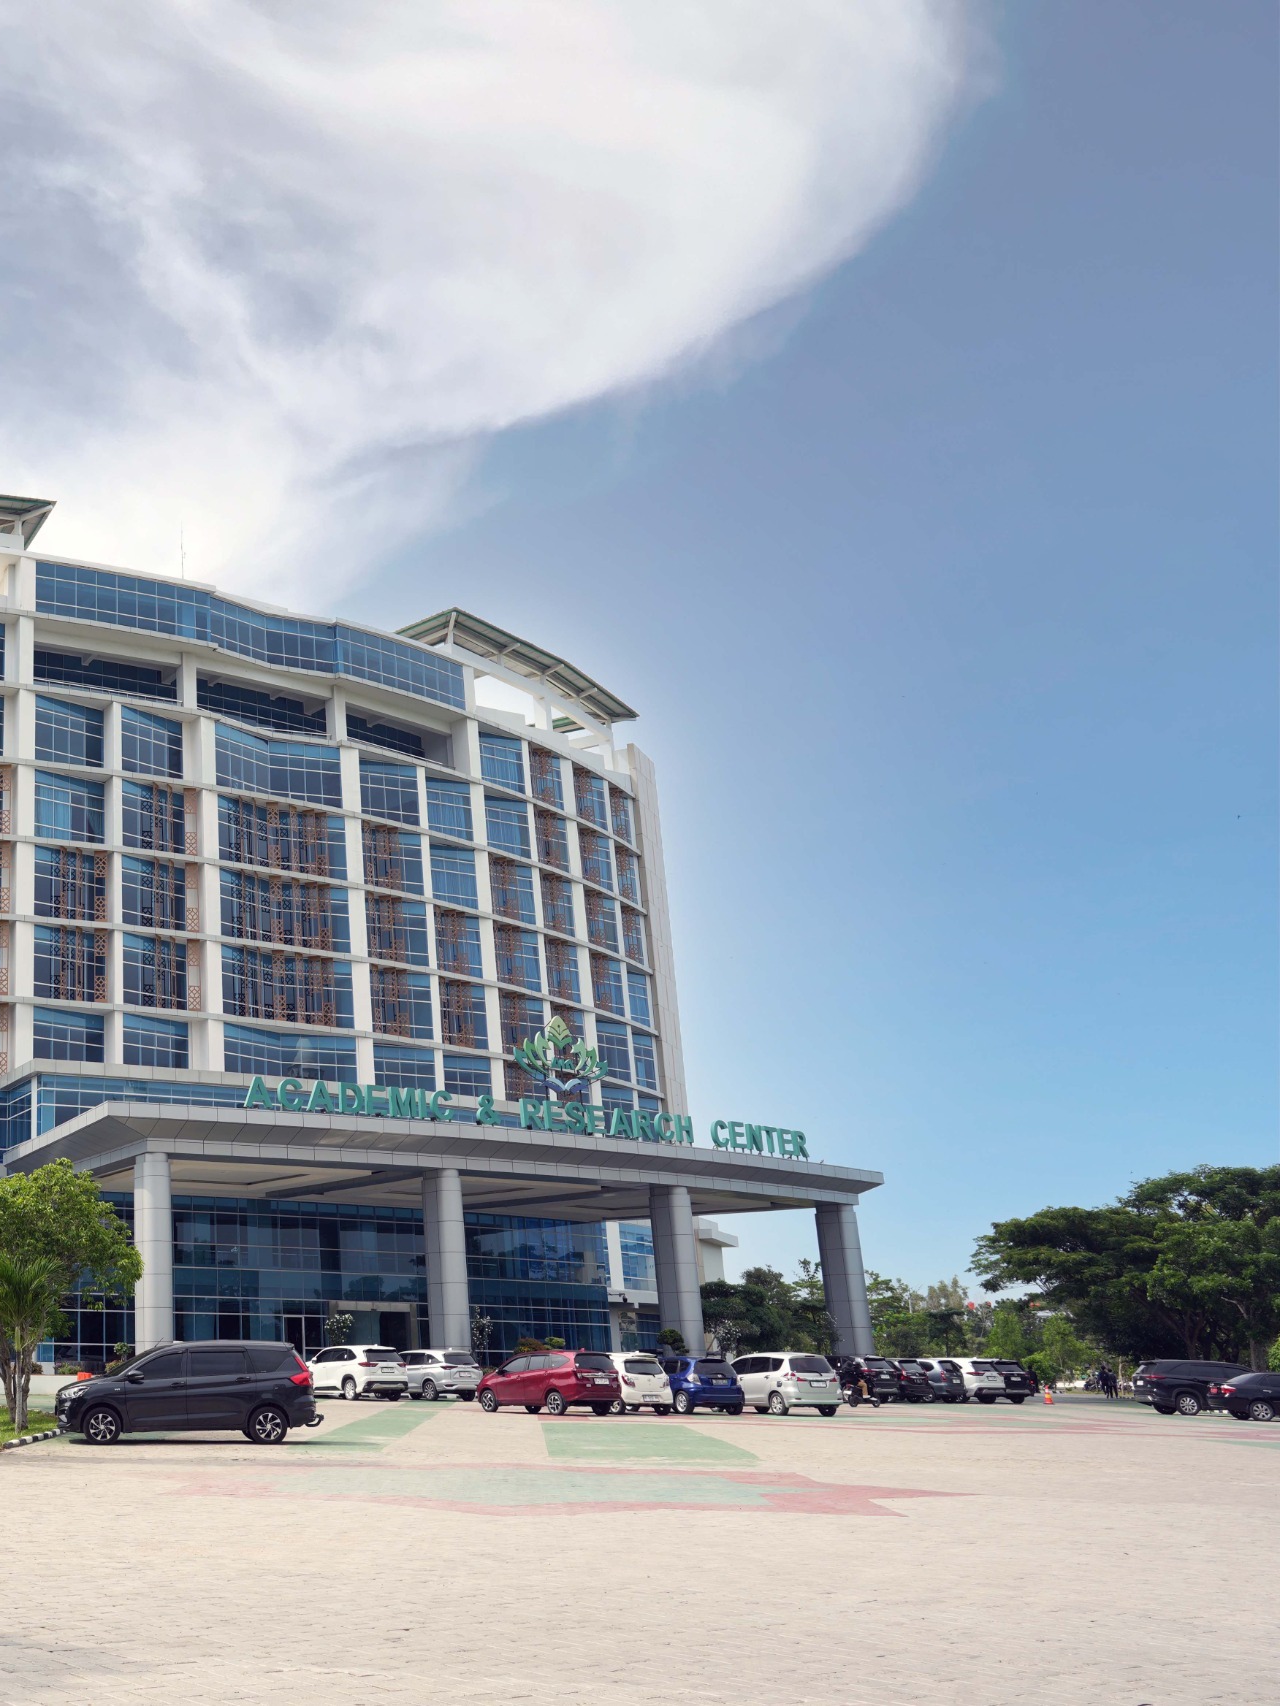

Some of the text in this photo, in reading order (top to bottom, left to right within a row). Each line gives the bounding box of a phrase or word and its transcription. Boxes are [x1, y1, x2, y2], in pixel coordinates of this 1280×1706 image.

[244, 1076, 810, 1158] ACADEMIC & RESEARCH CENTER
